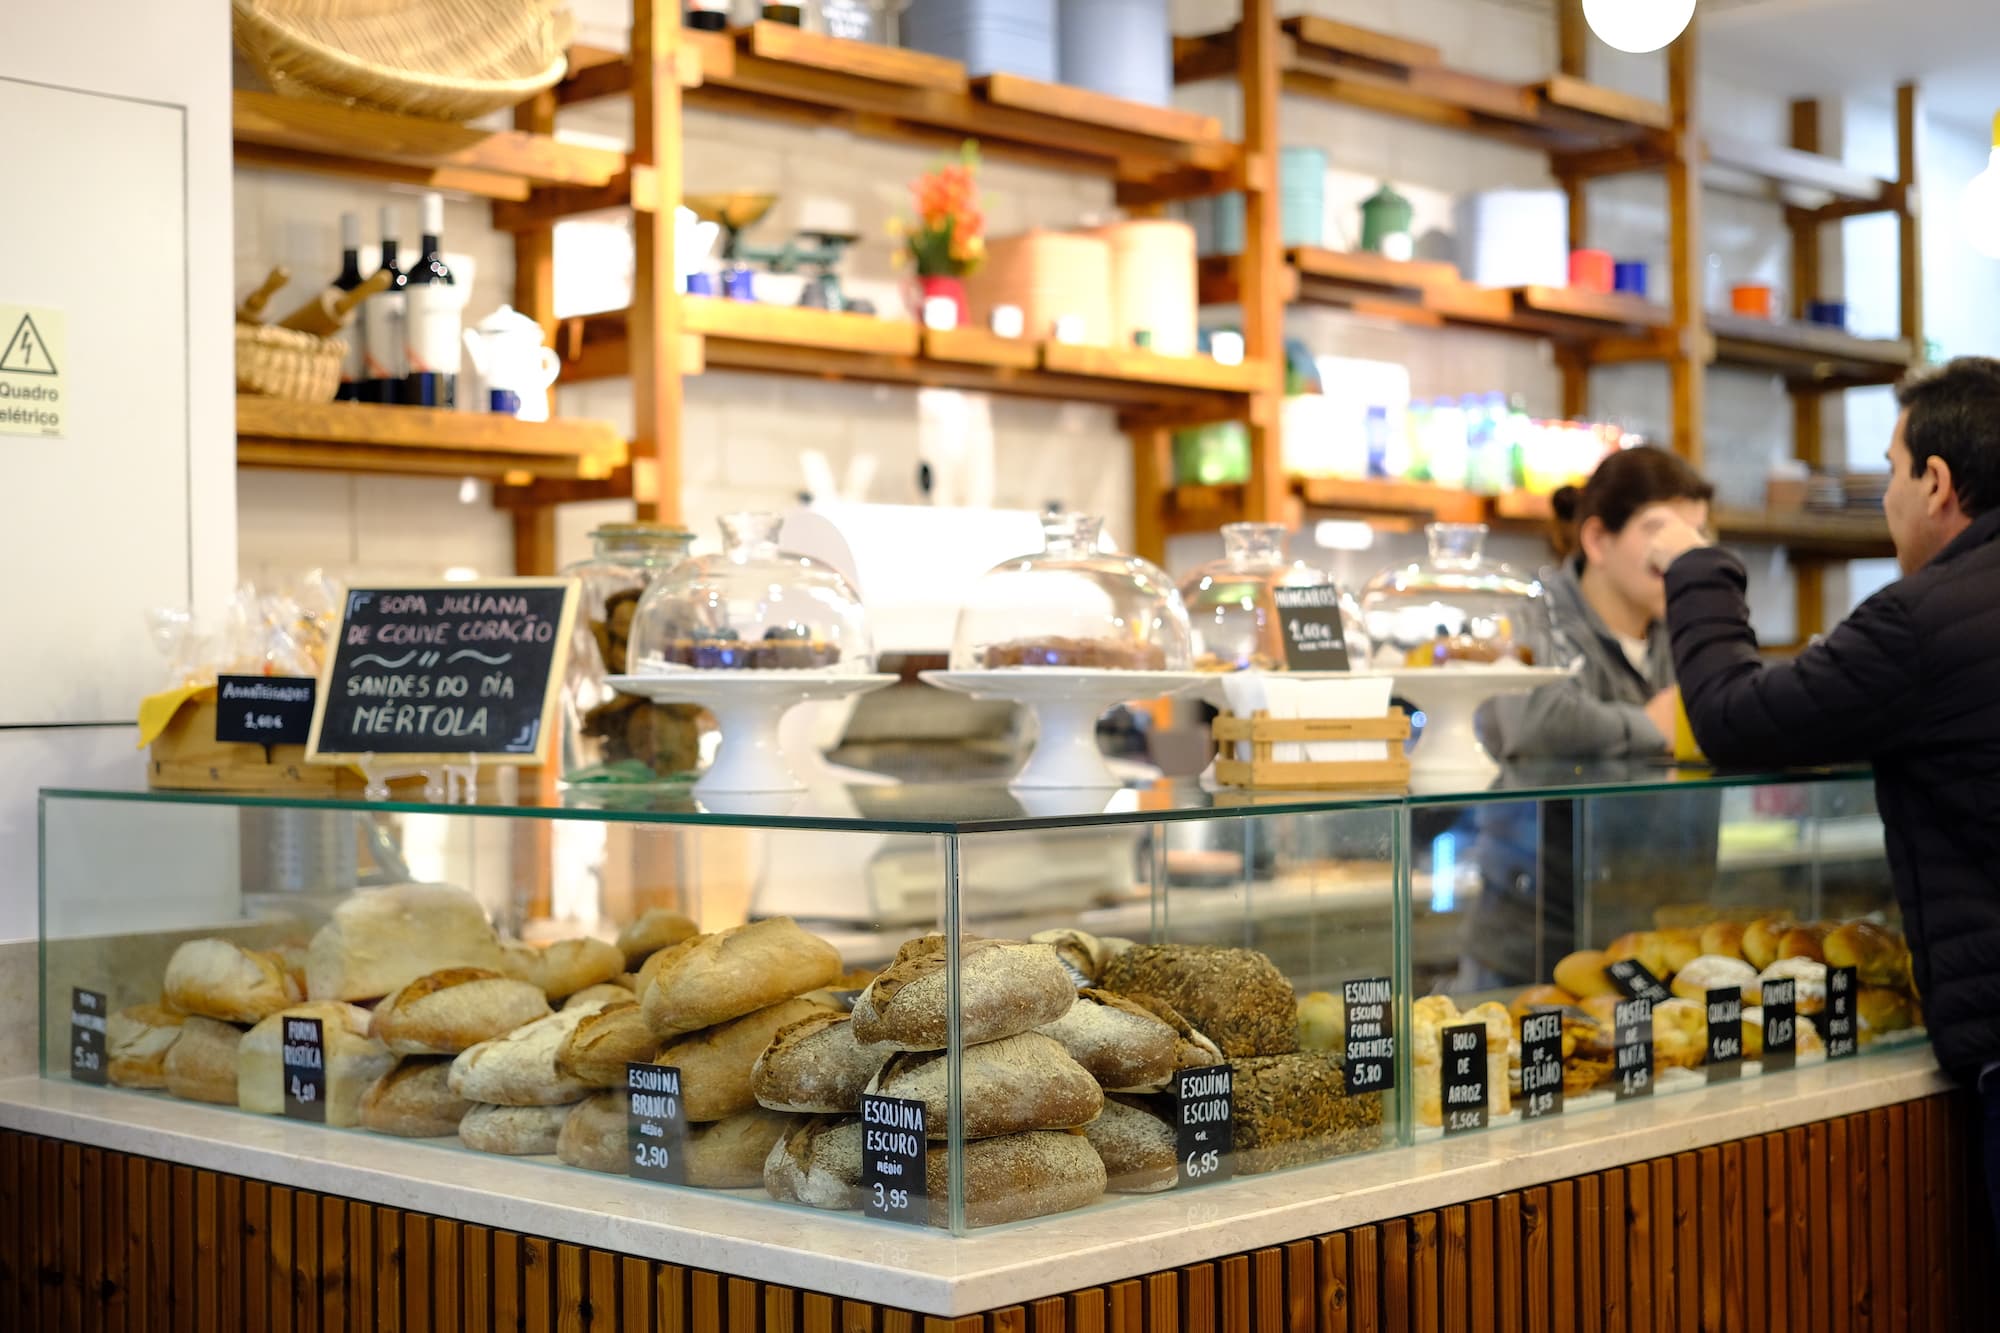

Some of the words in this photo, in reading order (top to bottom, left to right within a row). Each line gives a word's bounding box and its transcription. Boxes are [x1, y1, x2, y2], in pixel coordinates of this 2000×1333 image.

[0, 382, 59, 402] Quadro
[0, 406, 59, 426] elétrico
[379, 595, 428, 616] SOPA
[436, 593, 529, 616] JULIANA
[347, 625, 371, 646] DE
[376, 622, 452, 645] COUVE
[457, 615, 553, 643] CORAÇÃO
[346, 674, 431, 698] SANDES
[435, 675, 469, 698] DO
[351, 699, 489, 736] MÉRTOLA
[1345, 977, 1391, 1004] ESQUINA
[1350, 1005, 1383, 1022] ESCURO
[1350, 1022, 1381, 1038] FORMA
[1452, 1032, 1478, 1052] BOLO
[1523, 1015, 1561, 1043] PASTEL
[1347, 1038, 1393, 1060] SEMENTES
[1533, 1047, 1545, 1062] DE
[1457, 1057, 1470, 1075] DE
[1523, 1053, 1561, 1091] FEIJÃO
[629, 1068, 679, 1096] ESQUINA
[1181, 1068, 1230, 1100] ESQUINA
[1447, 1083, 1482, 1104] ARROZ
[632, 1093, 676, 1120] BRANCO
[864, 1099, 923, 1132] ESQUINA
[1183, 1098, 1229, 1125] ESCURO
[635, 1142, 669, 1169] 2,90
[867, 1129, 918, 1159] ESCURO
[876, 1155, 903, 1176] MÉDIO
[1186, 1149, 1219, 1178] 6,95
[872, 1182, 909, 1213] 3,95
